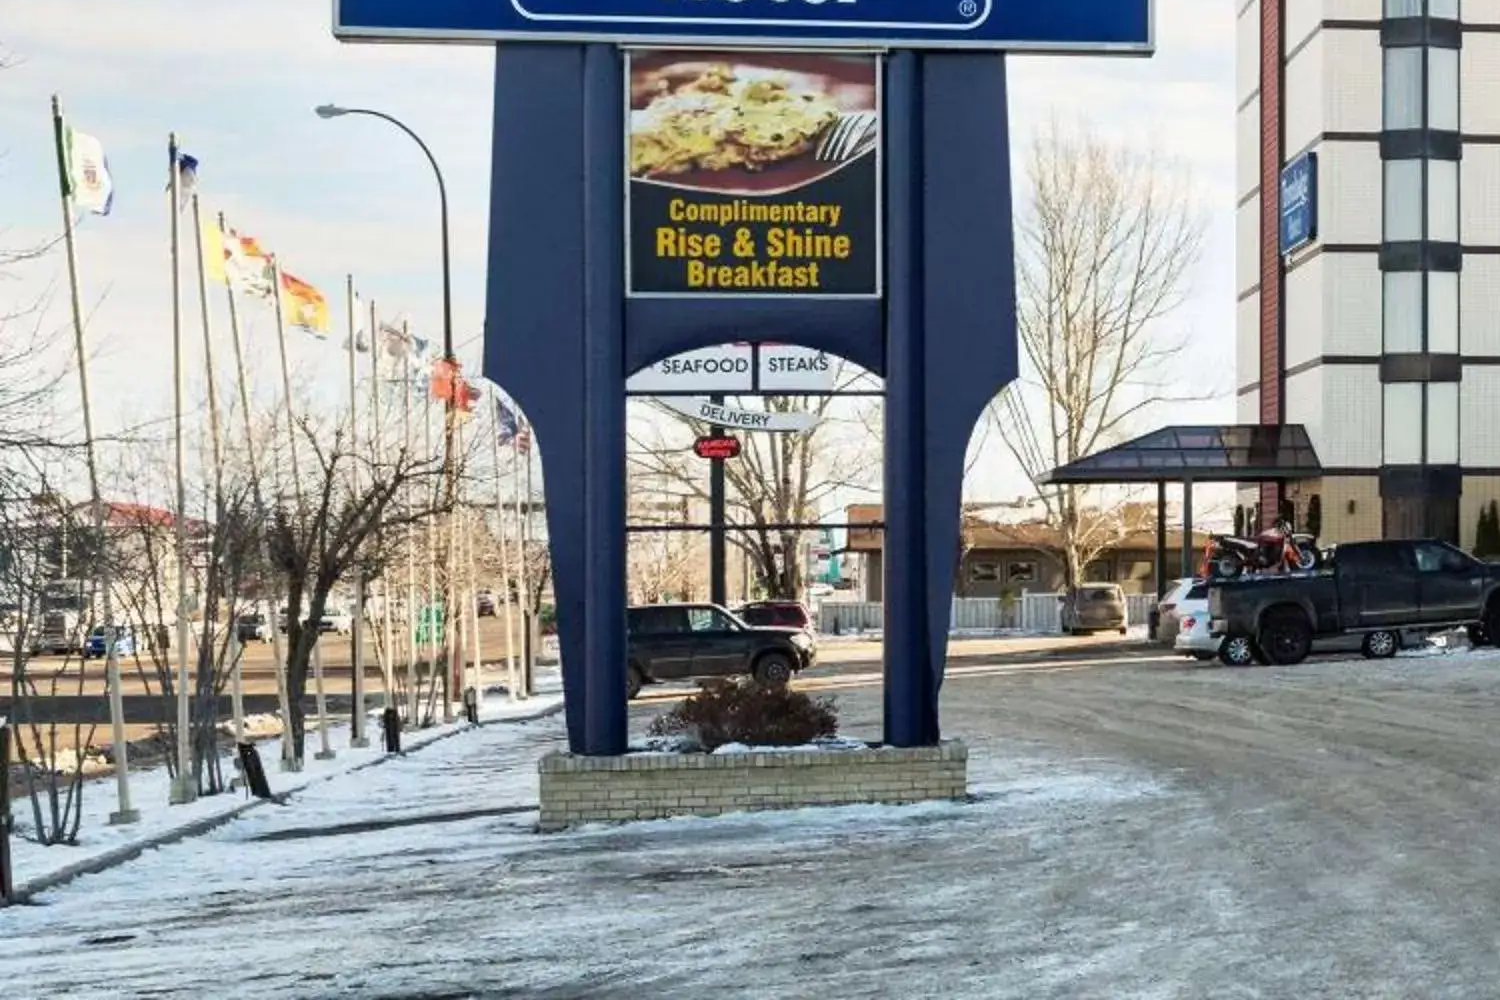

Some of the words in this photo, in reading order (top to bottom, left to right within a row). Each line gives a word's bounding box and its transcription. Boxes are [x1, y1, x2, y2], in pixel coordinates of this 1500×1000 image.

[670, 199, 841, 227] Complimentary
[657, 227, 721, 257] Rise
[733, 227, 754, 257] &
[767, 227, 851, 258] Shine
[688, 259, 819, 287] Breakfast
[662, 357, 748, 374] SEAFOOD
[769, 356, 829, 372] STEAKS
[701, 404, 772, 426] DELIVERY
